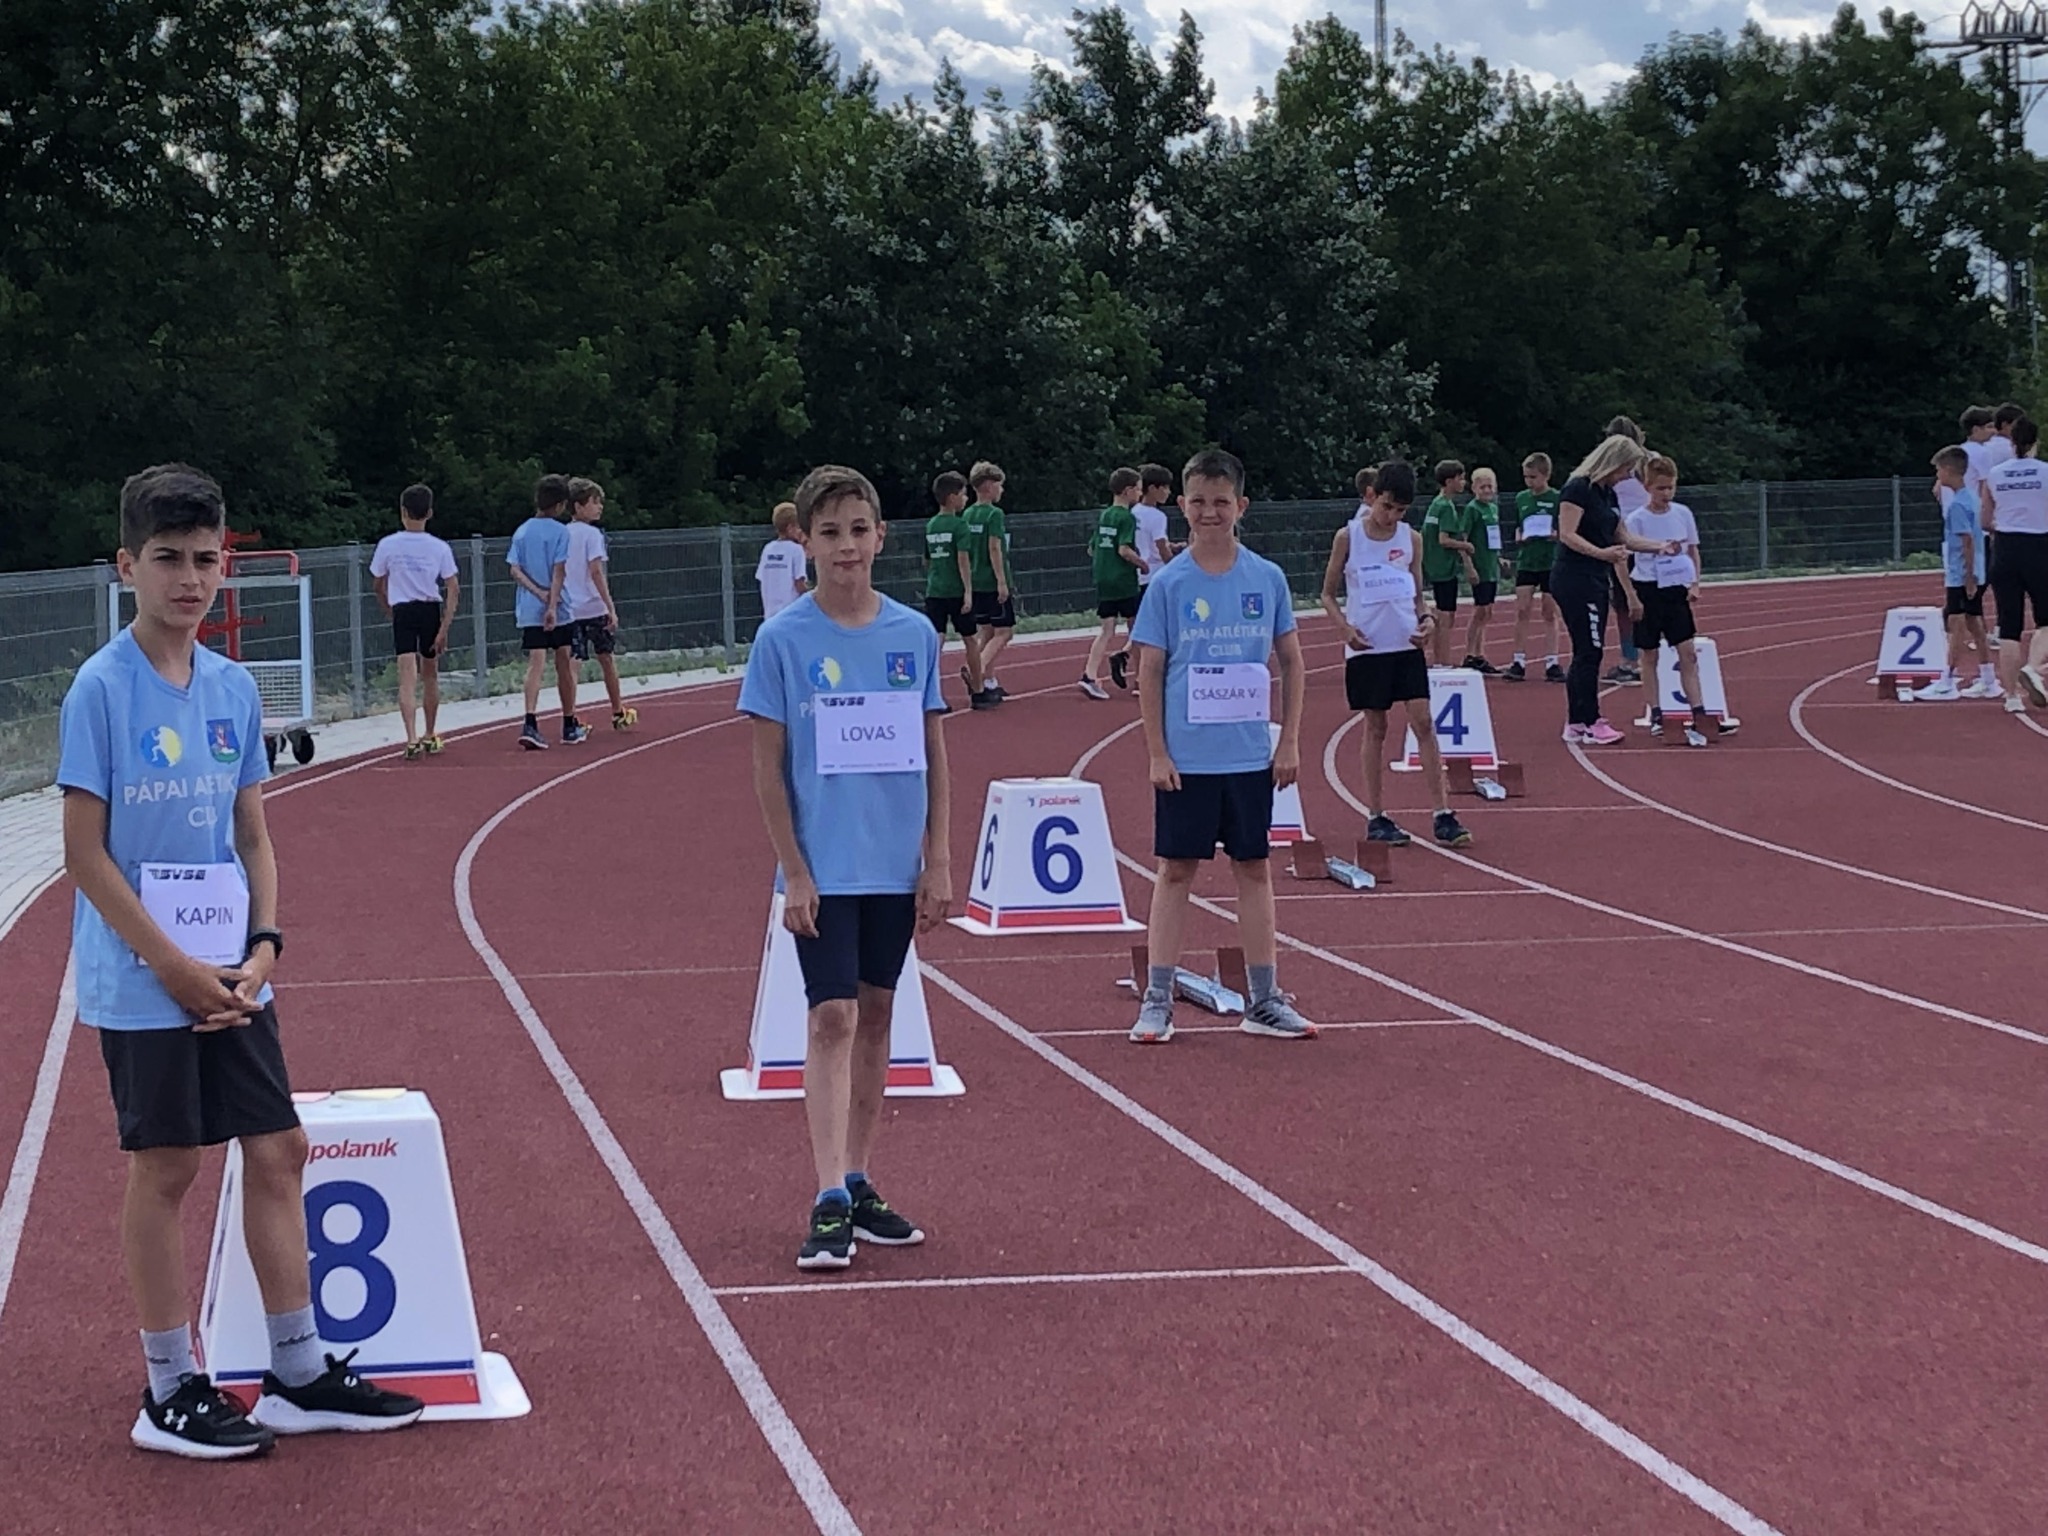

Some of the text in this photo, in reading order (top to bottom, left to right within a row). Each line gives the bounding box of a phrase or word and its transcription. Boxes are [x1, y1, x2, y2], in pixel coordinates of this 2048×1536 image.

[1898, 625, 1925, 665] 2
[841, 724, 897, 742] LOVAS
[1434, 692, 1470, 746] 4
[123, 776, 189, 806] PÁPAI
[981, 813, 999, 892] 6
[1031, 814, 1084, 895] 6
[175, 906, 234, 926] KAPIN
[308, 1137, 399, 1165] polanik
[303, 1179, 397, 1344] 8
